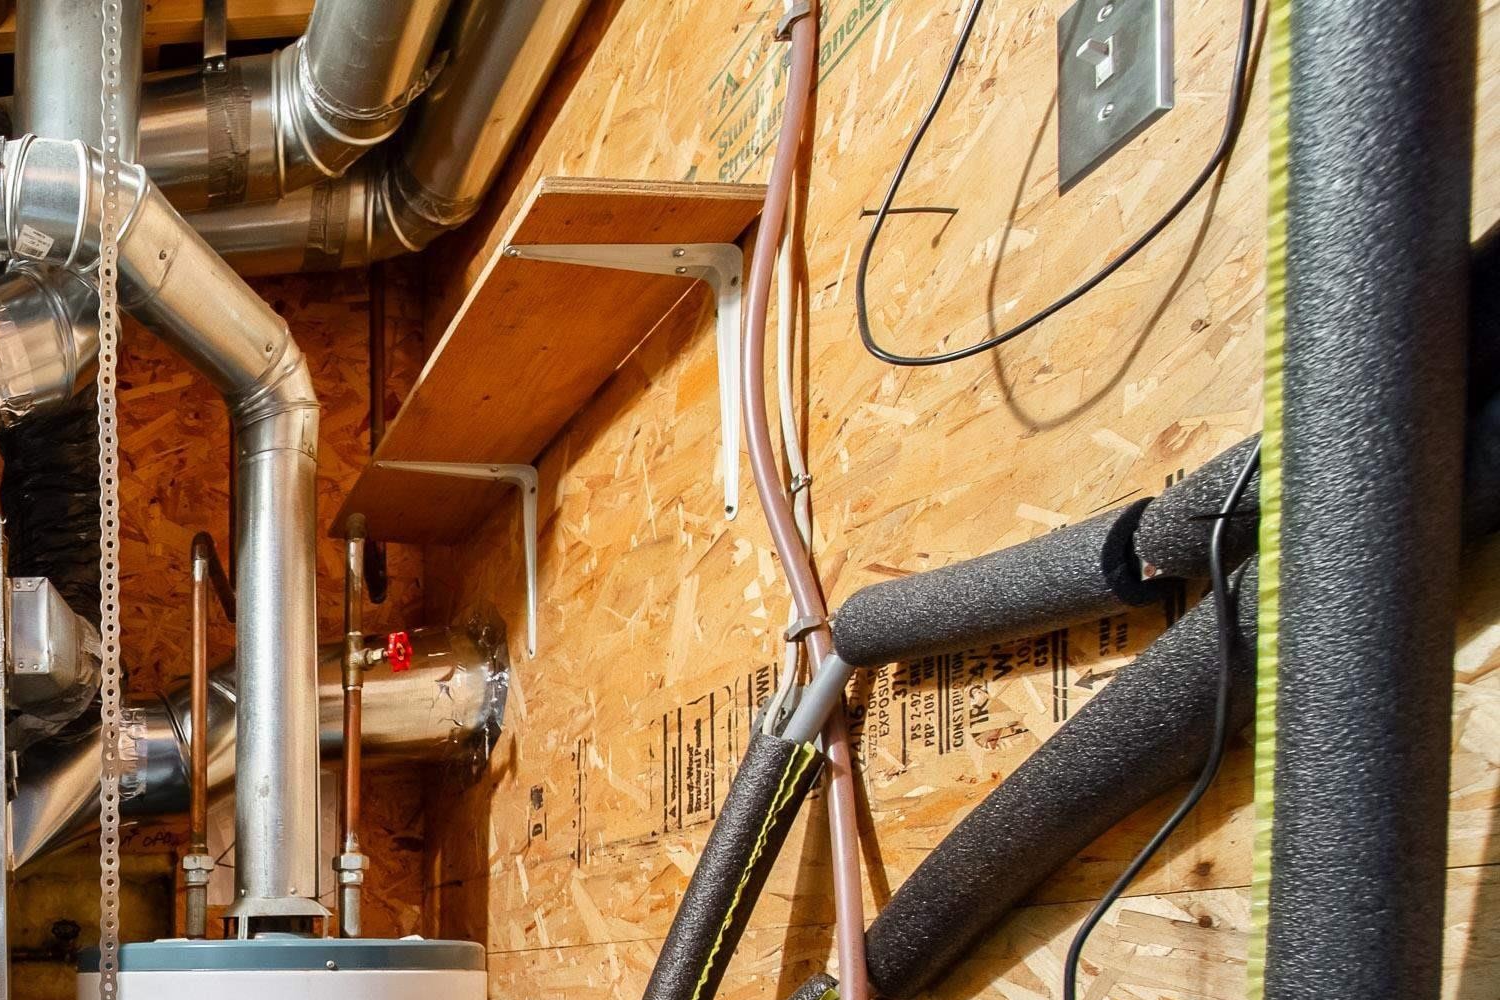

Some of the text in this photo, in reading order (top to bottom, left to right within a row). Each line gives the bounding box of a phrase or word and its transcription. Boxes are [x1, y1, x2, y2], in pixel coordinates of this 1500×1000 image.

[879, 666, 890, 738] EXPOSUR
[910, 690, 922, 721] 2-92
[924, 692, 936, 748] PRP-108
[910, 723, 922, 741] PS
